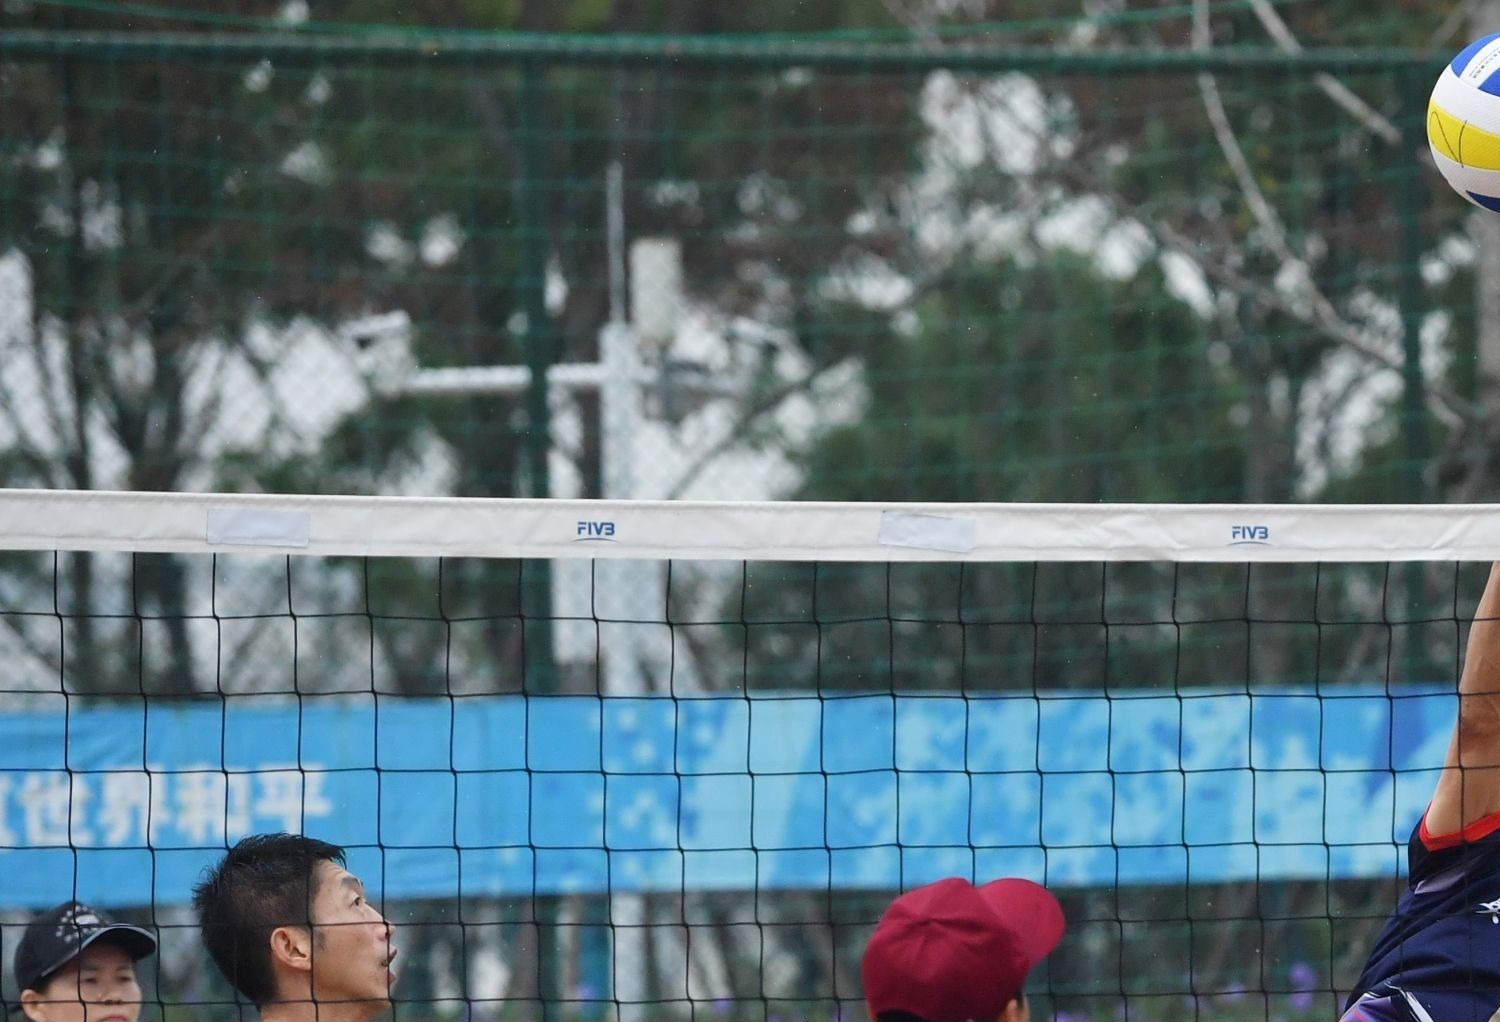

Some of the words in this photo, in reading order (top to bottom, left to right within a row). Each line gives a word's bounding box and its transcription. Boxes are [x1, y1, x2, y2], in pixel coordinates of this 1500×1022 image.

[577, 521, 615, 536] FIVB
[1231, 525, 1269, 540] FIVB
[0, 761, 333, 848] 世界和平
